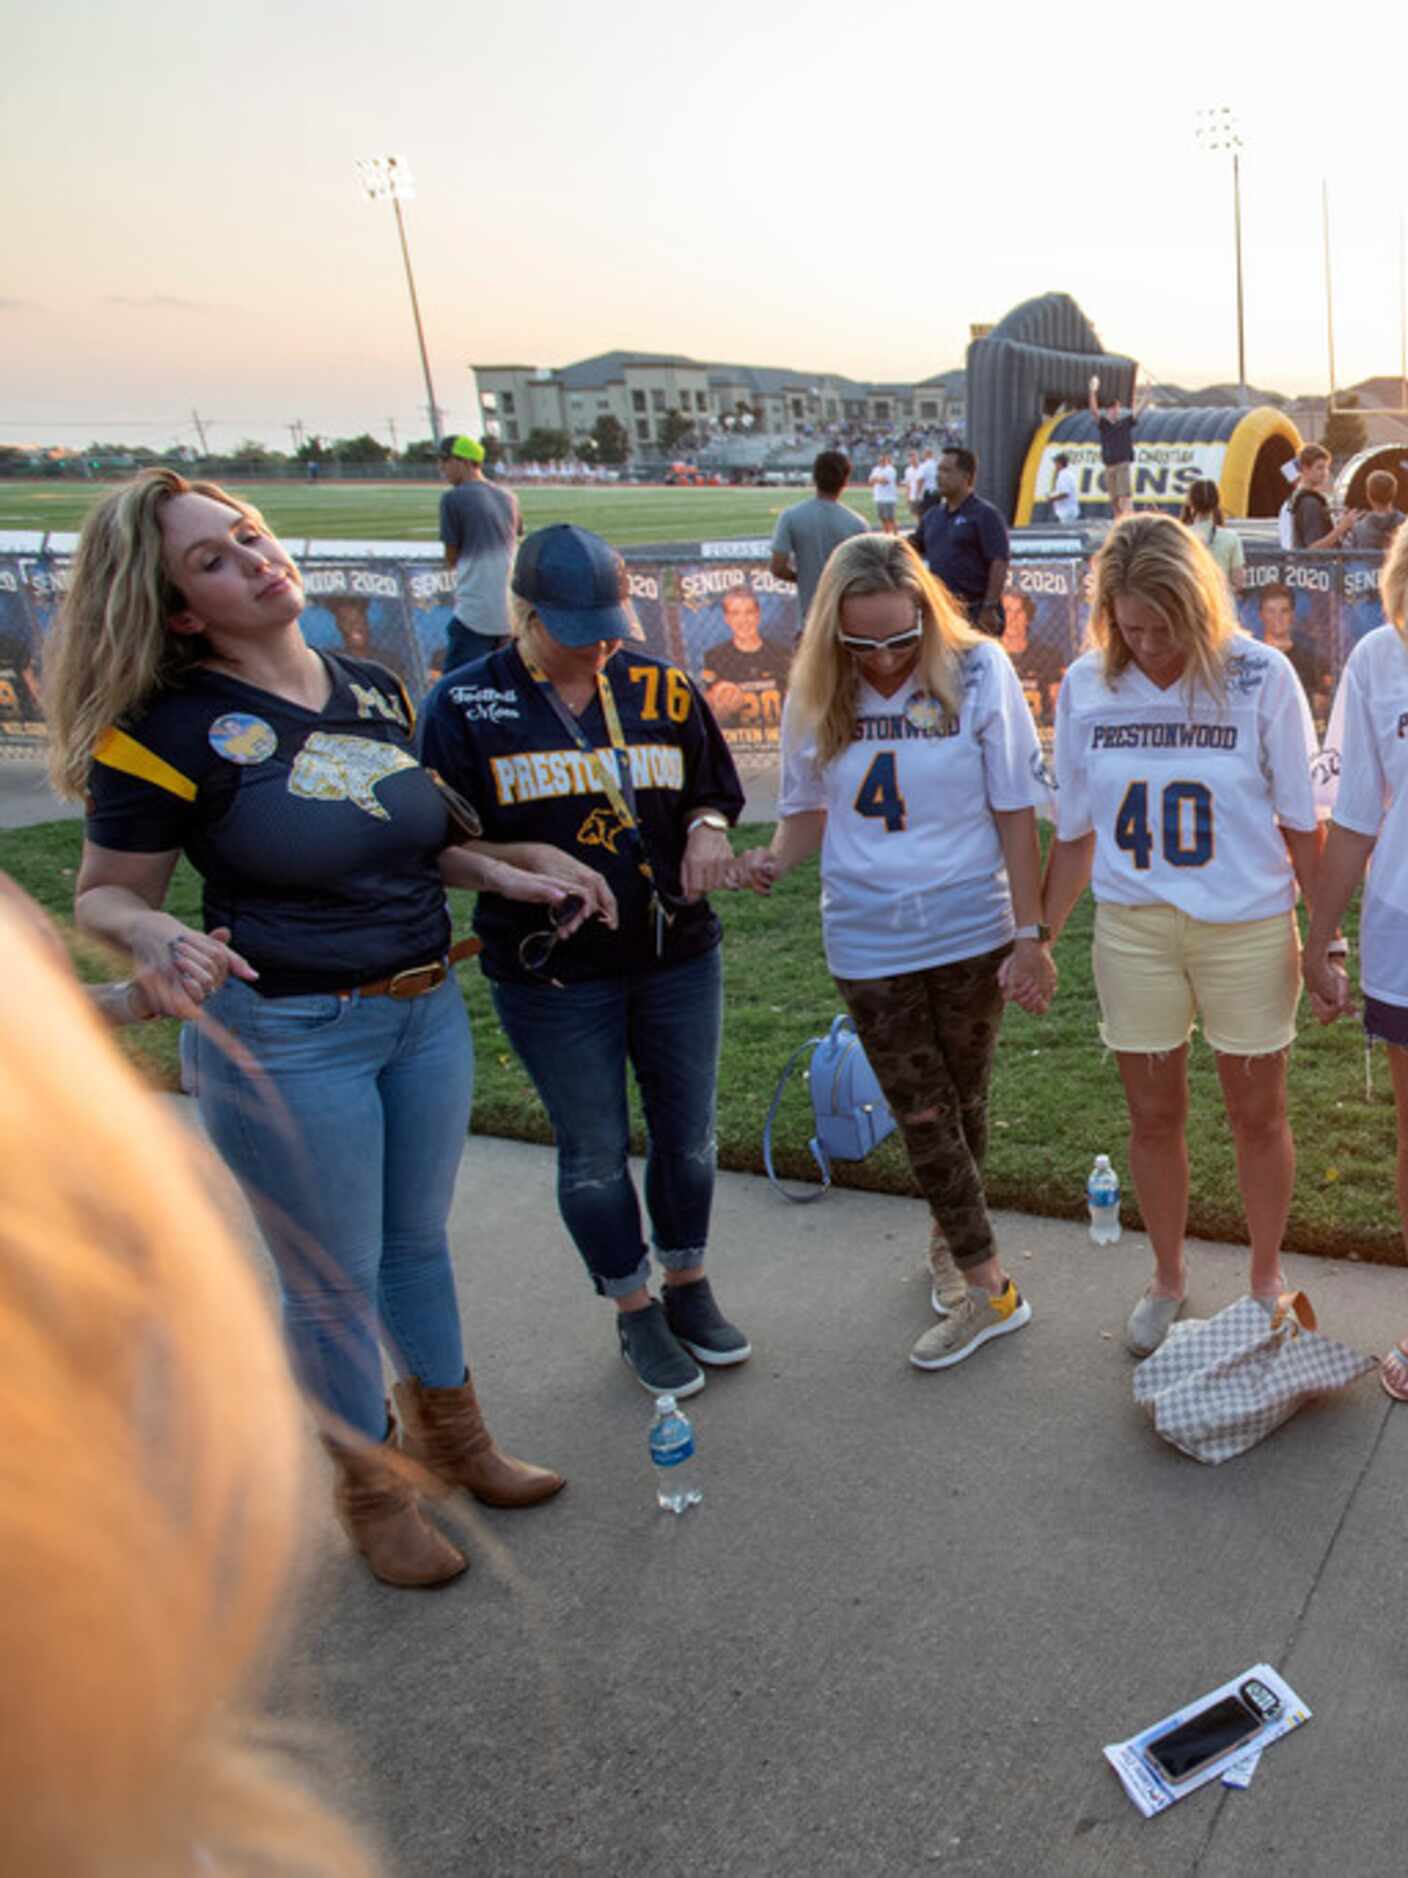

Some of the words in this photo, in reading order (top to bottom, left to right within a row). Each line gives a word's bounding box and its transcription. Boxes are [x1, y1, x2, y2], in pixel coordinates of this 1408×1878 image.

[681, 568, 746, 597] SENIOR
[1019, 570, 1069, 594] 2020
[1285, 566, 1331, 590] 2020
[629, 666, 692, 723] 76
[1091, 722, 1238, 751] PRESTONWOOD
[854, 750, 907, 833] 4
[1114, 780, 1215, 870] 40
